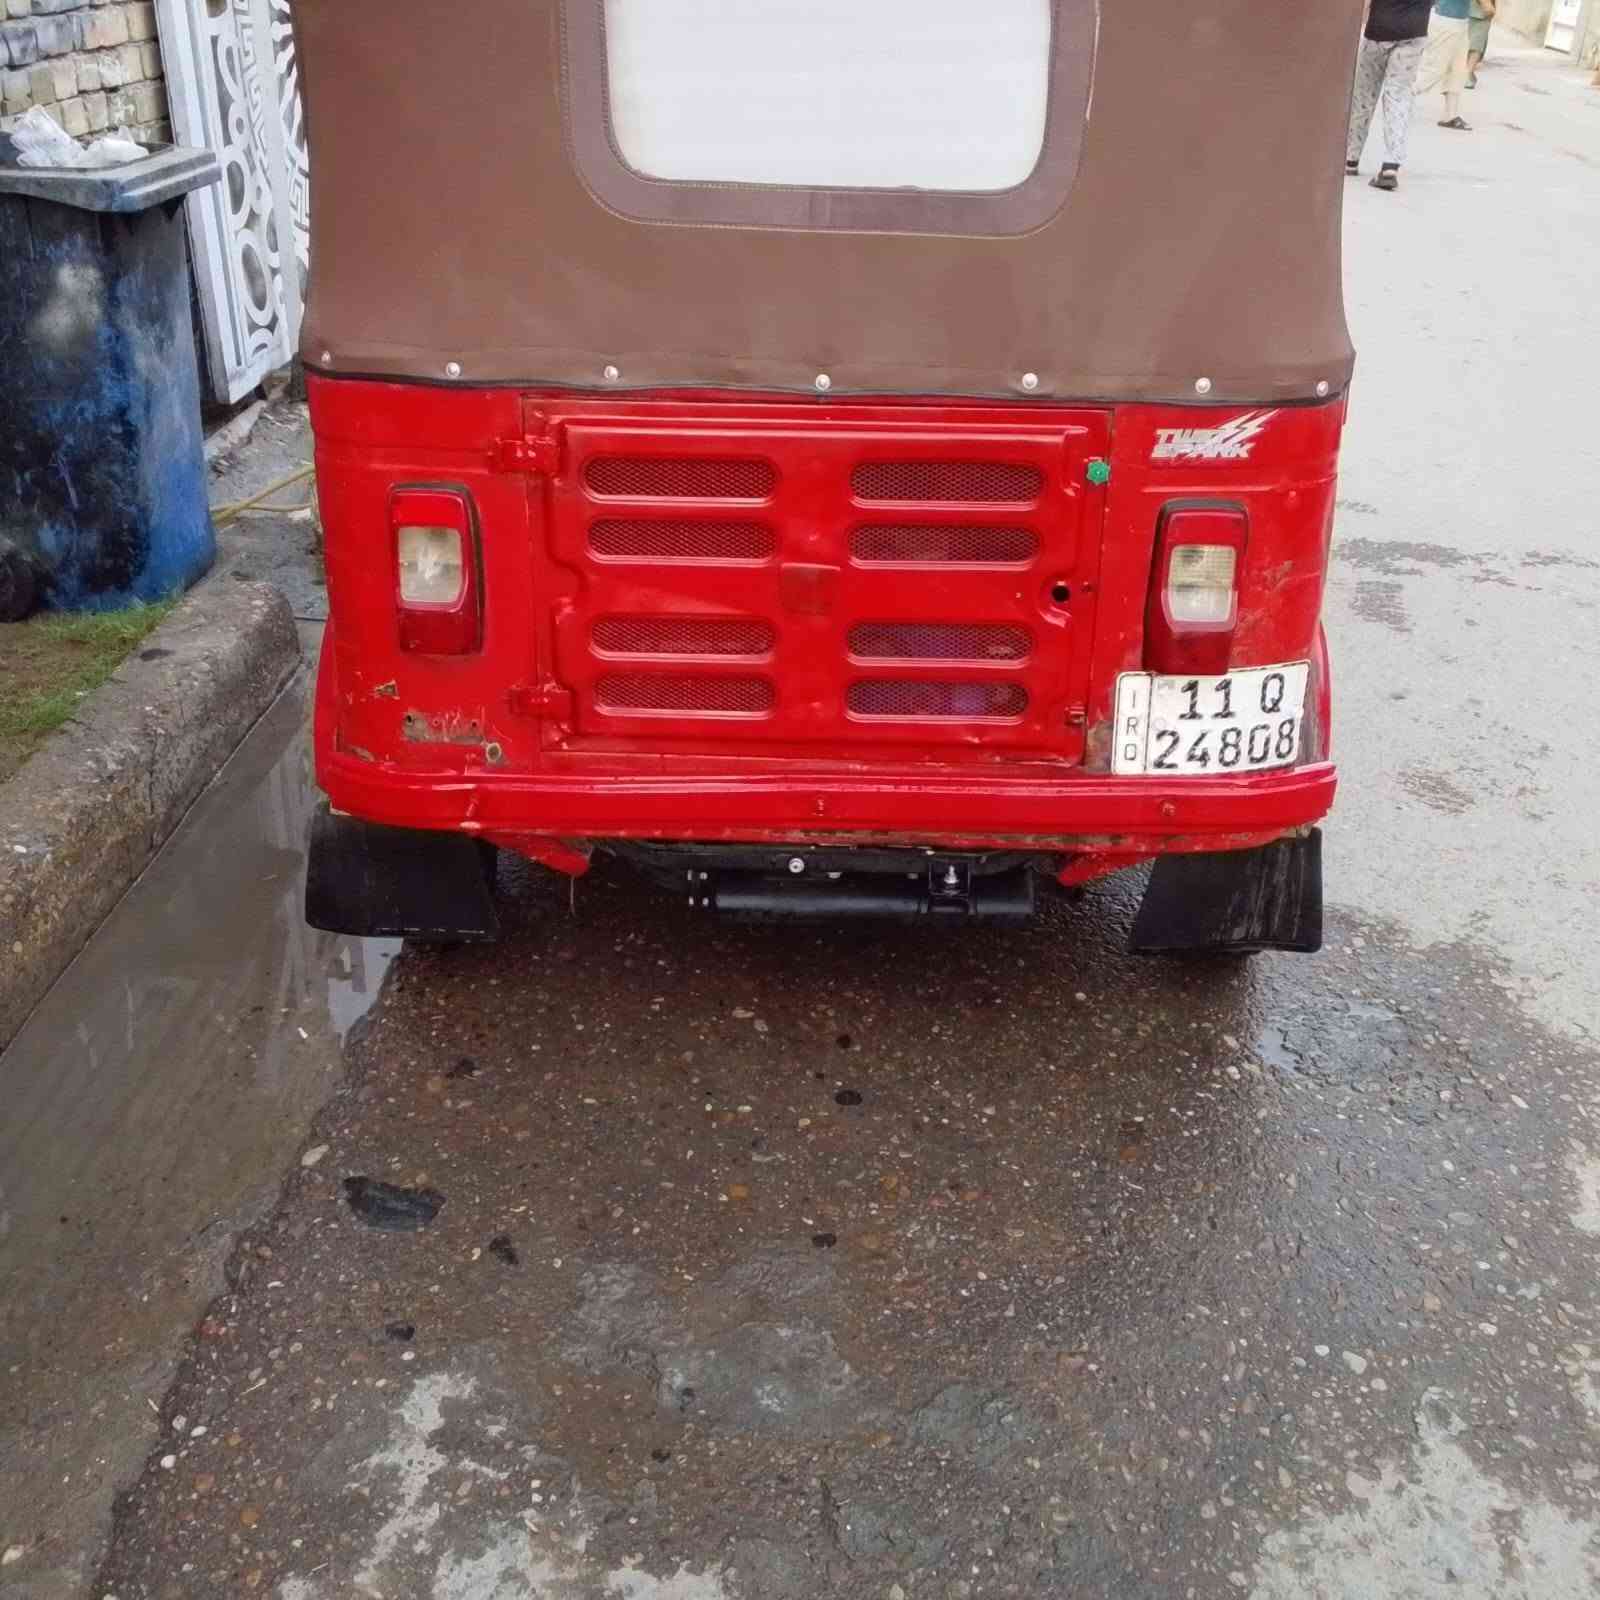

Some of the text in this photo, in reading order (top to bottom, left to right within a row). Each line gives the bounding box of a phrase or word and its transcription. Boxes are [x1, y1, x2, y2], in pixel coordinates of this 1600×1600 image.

[1178, 672, 1285, 720] 11 Q
[1153, 718, 1295, 769] 24808
